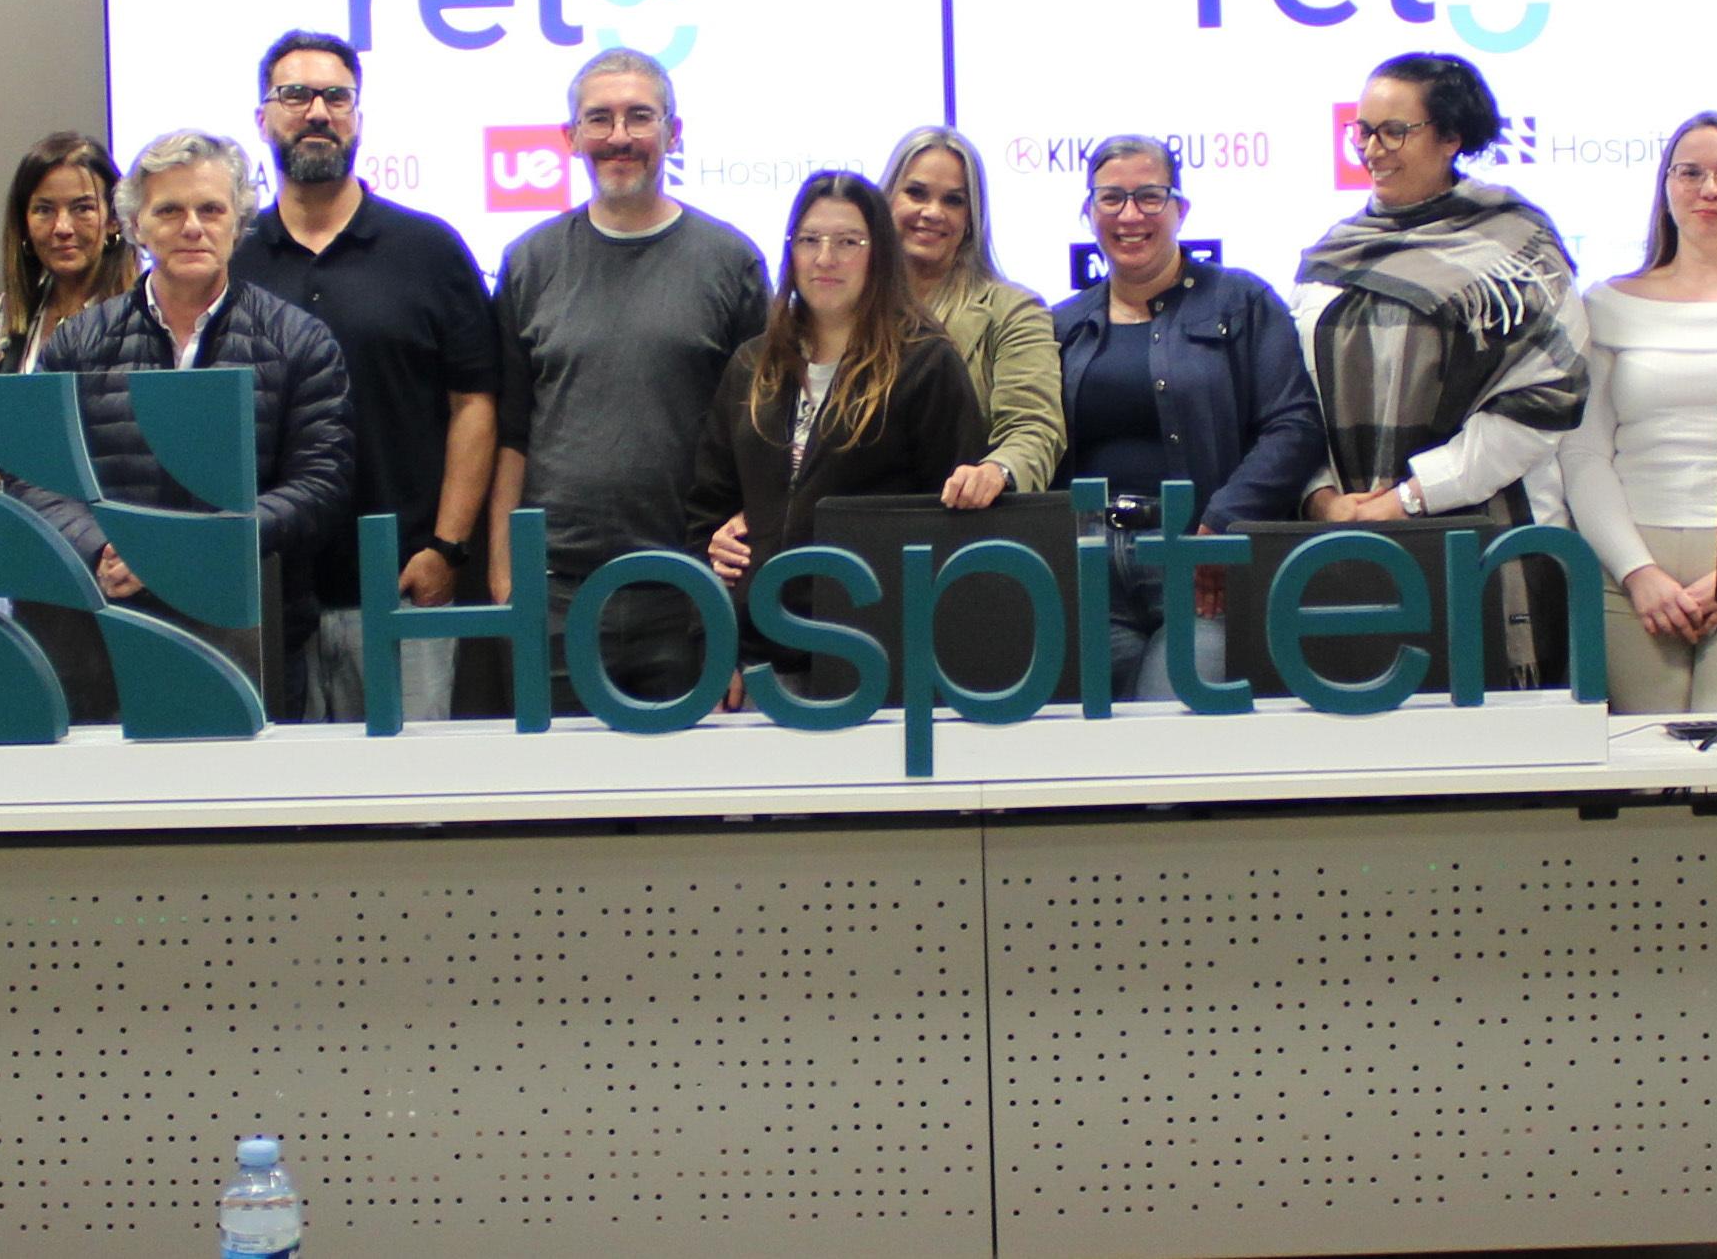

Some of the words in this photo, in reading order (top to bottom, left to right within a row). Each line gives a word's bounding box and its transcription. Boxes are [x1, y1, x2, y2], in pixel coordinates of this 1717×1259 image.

[1551, 131, 1673, 170] Hospit
[365, 155, 420, 191] 360
[359, 478, 1608, 777] Hospiten
